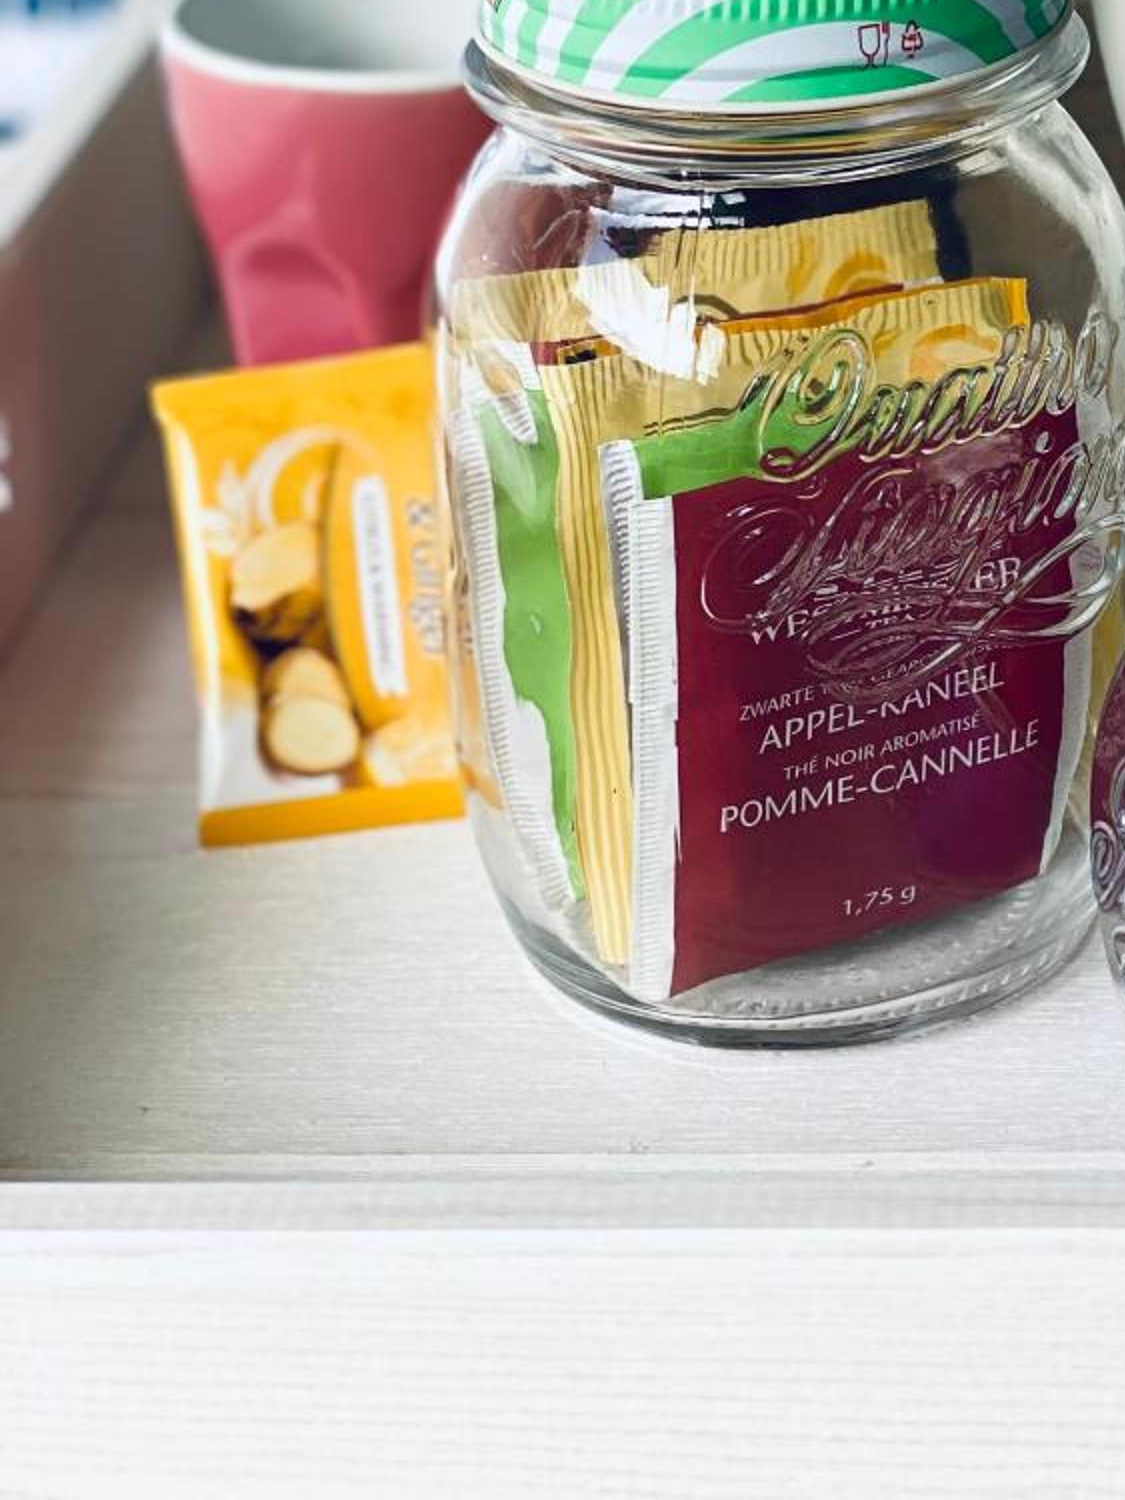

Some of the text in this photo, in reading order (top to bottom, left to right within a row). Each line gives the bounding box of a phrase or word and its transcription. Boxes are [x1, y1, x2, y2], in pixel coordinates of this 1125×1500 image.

[739, 684, 815, 722] ZWARTE
[759, 661, 1006, 754] APPEL-KANEEL
[719, 718, 1041, 834] POMME-CANNELLE
[783, 709, 983, 781] THÉ NOIR AROMATISÉ
[842, 884, 916, 917] 1,75 g
